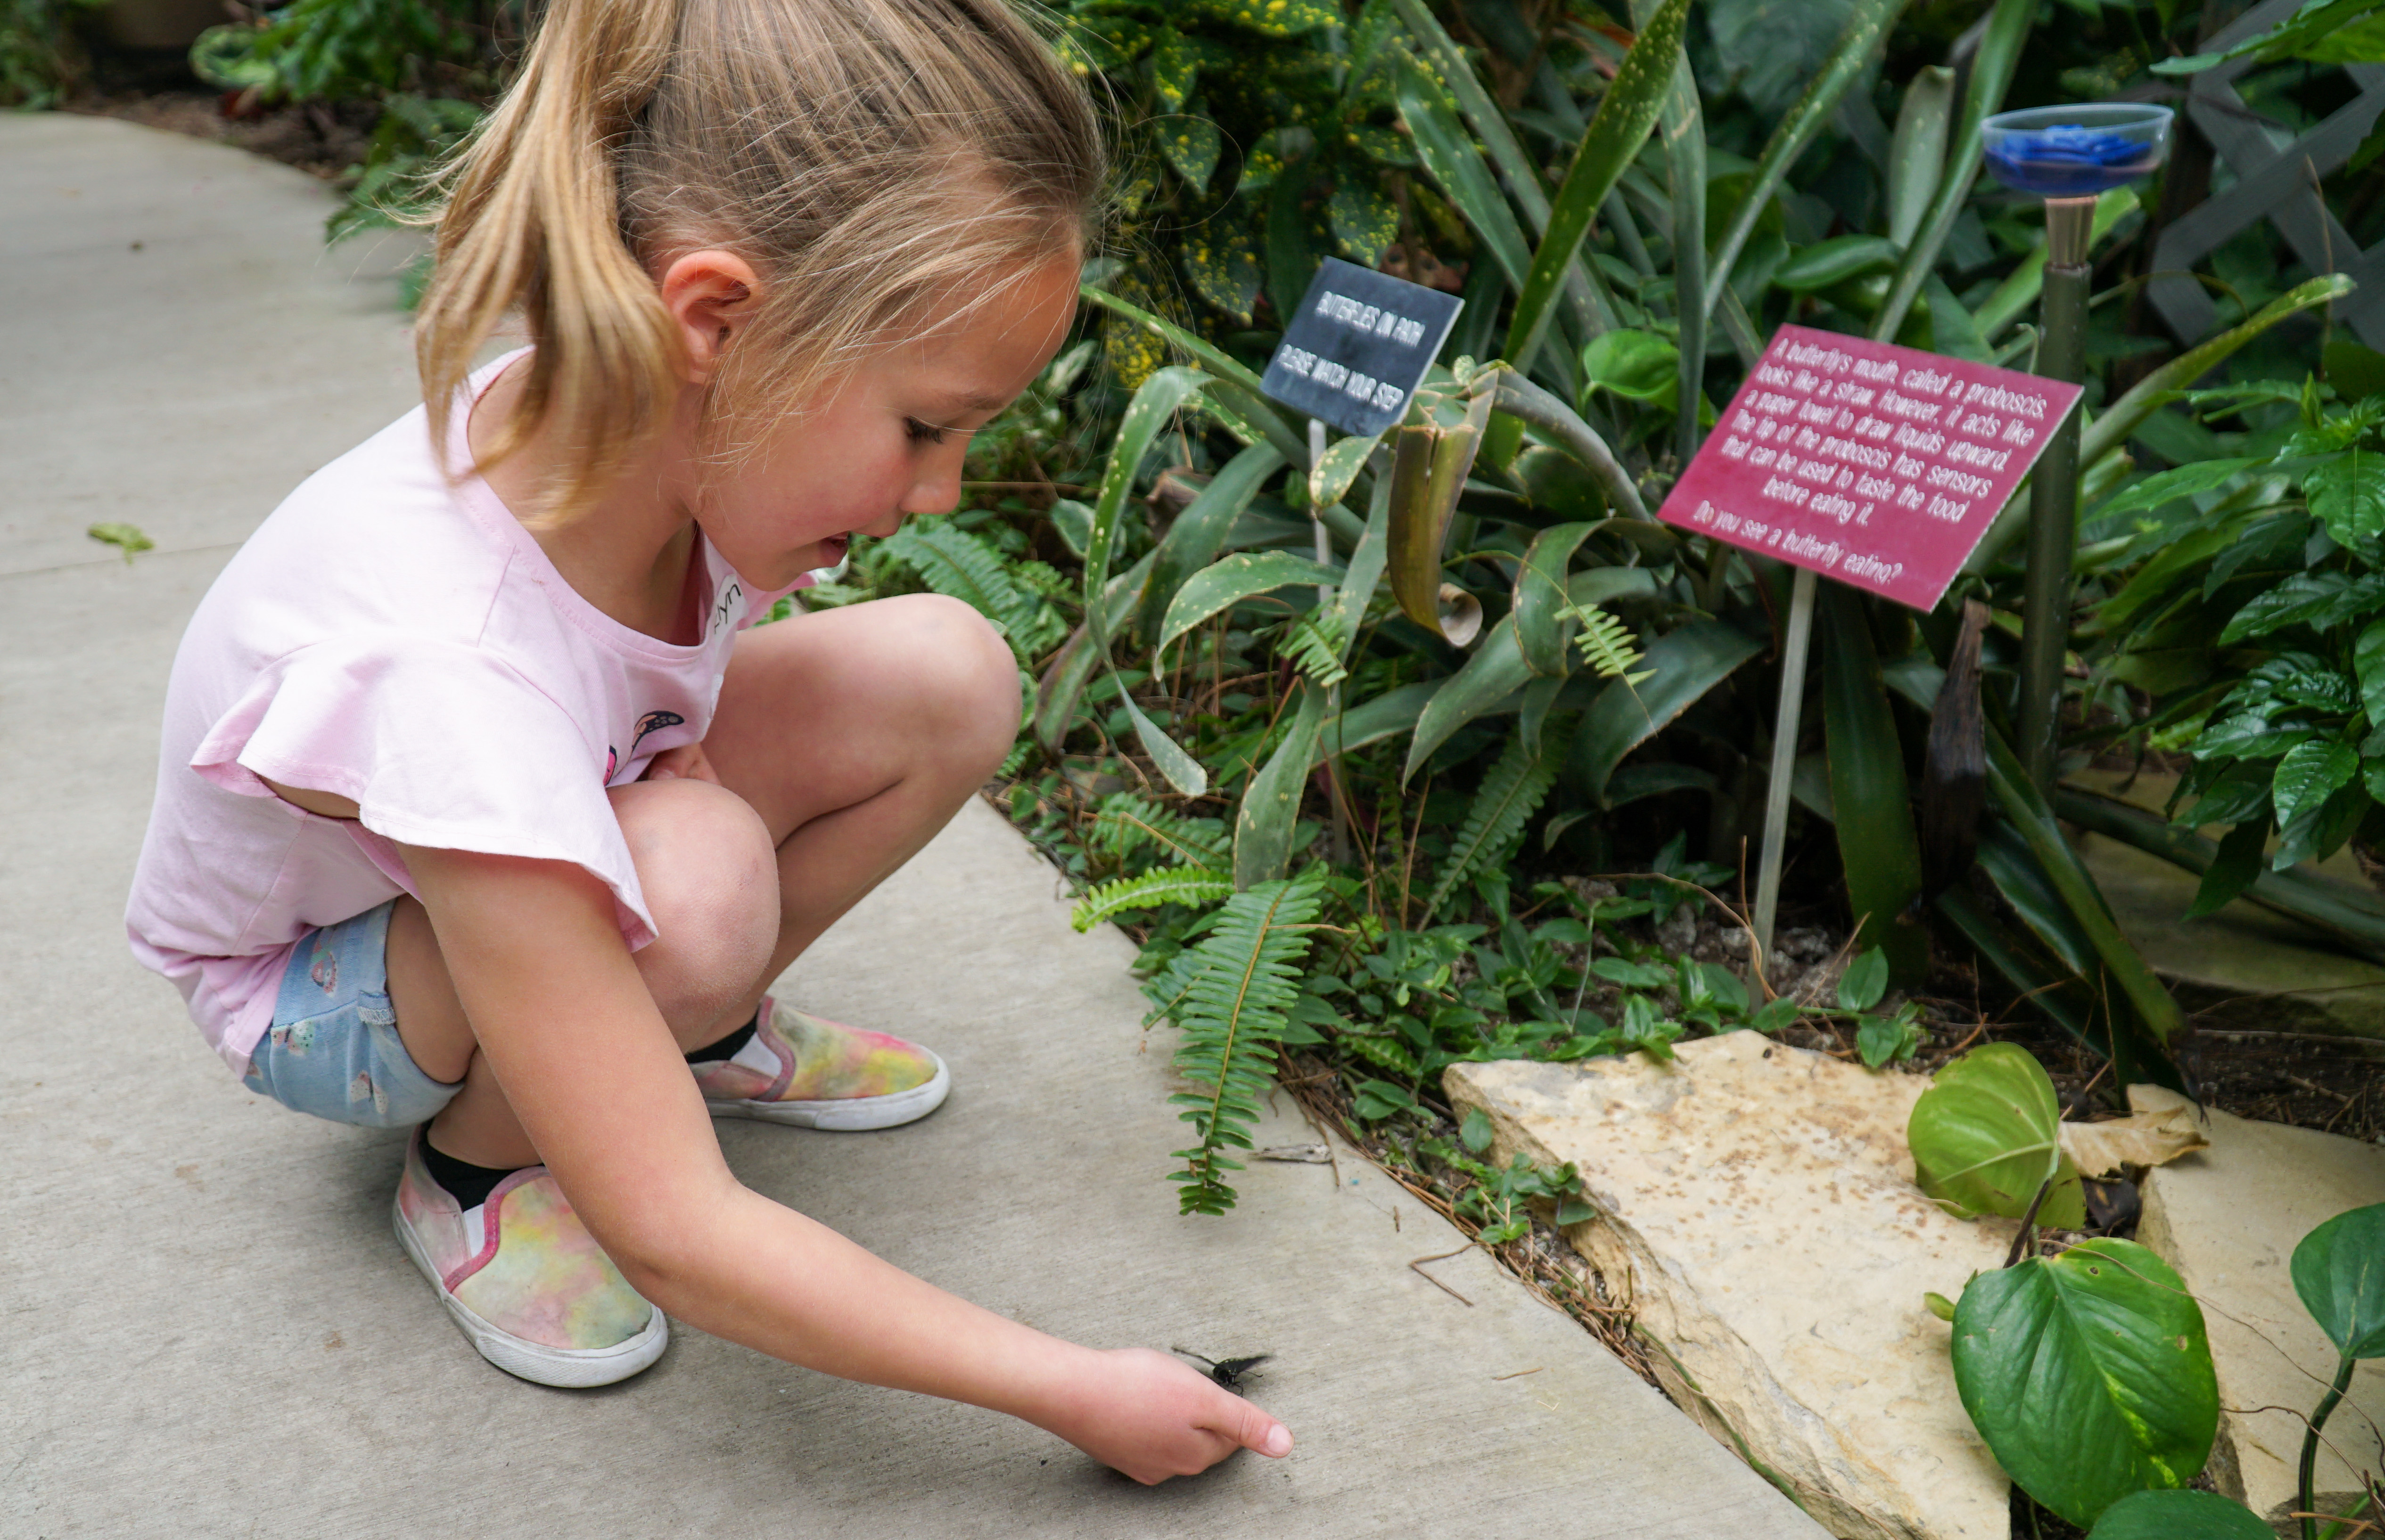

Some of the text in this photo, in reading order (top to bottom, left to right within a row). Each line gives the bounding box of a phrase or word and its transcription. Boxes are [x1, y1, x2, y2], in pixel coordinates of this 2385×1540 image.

[1756, 361, 1793, 387] looks
[1792, 369, 1819, 393] like
[1818, 379, 1833, 397] a
[1945, 405, 1964, 428] it
[1962, 413, 2000, 438] acts
[2002, 418, 2034, 446] like
[1772, 338, 1788, 359] A
[1903, 368, 1952, 395] called
[1949, 380, 1964, 399] a
[1732, 409, 1992, 498] The tip of the proboscis has sensors
[1744, 390, 1758, 406] a
[1755, 392, 1798, 415] paper
[1798, 398, 1839, 425] towel
[1836, 407, 1854, 430] to
[1855, 413, 1893, 440] draw
[1893, 422, 1945, 454] liquids
[1721, 434, 1970, 523] that can be used to taste the food
[1763, 474, 1874, 526] before eating it.
[1693, 500, 1902, 584] Do you see a butterfly eating?
